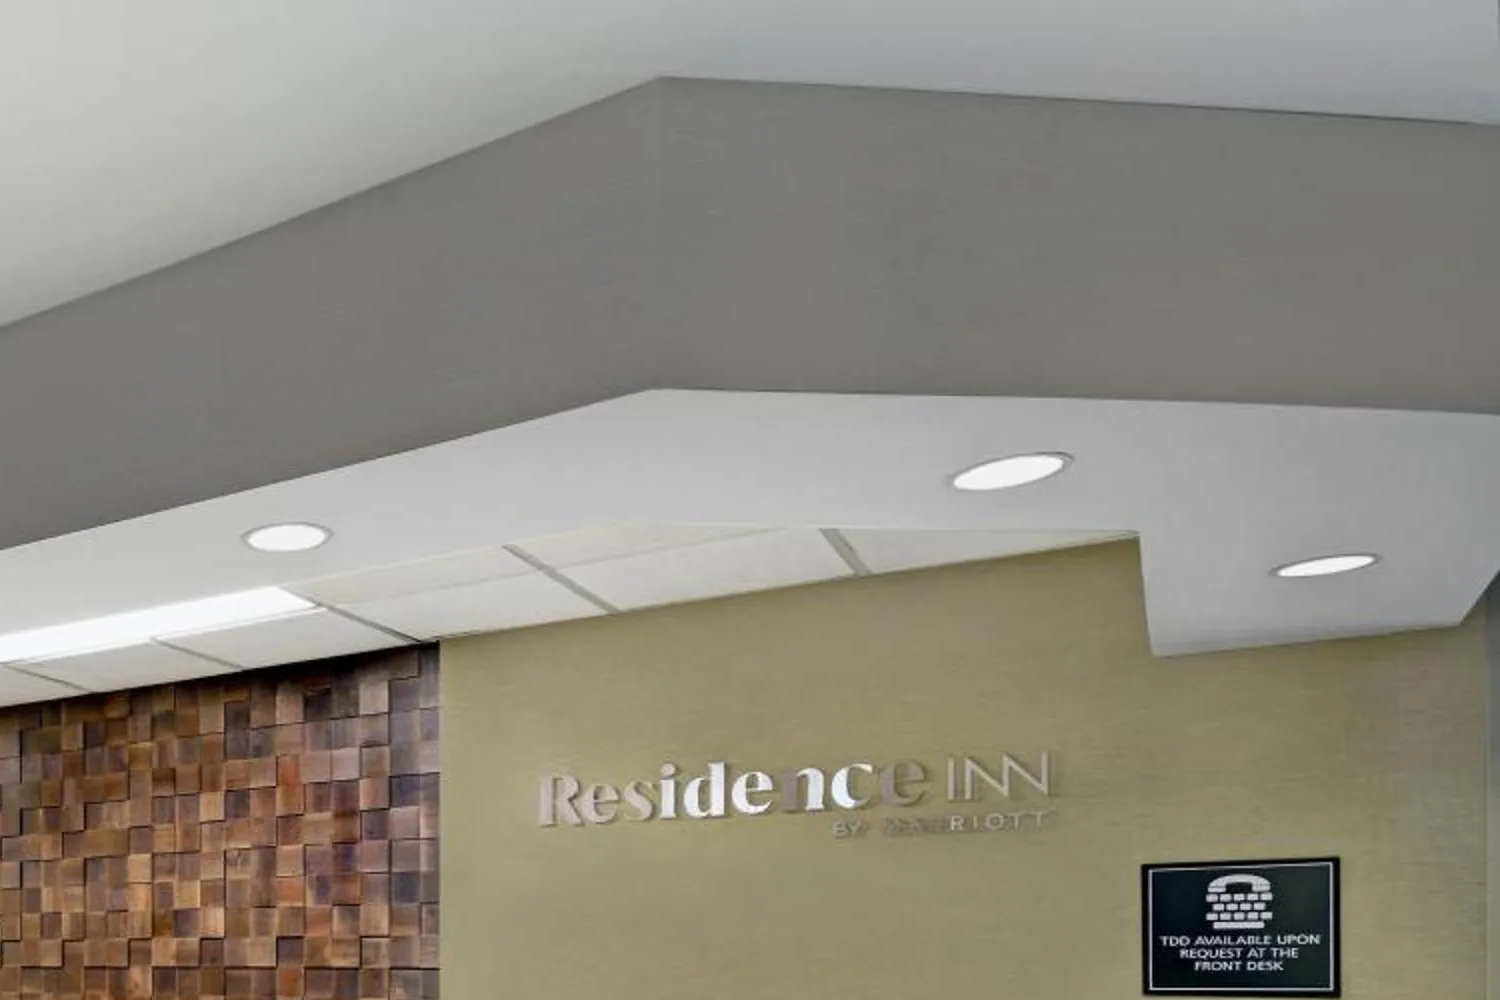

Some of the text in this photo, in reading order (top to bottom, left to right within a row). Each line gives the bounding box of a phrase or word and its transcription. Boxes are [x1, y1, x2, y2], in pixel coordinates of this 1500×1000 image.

[539, 750, 1049, 826] Residence INN
[833, 820, 862, 838] BY
[1160, 934, 1322, 947] TDD AVAILABLE UPON
[1179, 947, 1300, 960] REQUEST AT THE
[1193, 961, 1285, 972] FRONT DESK
